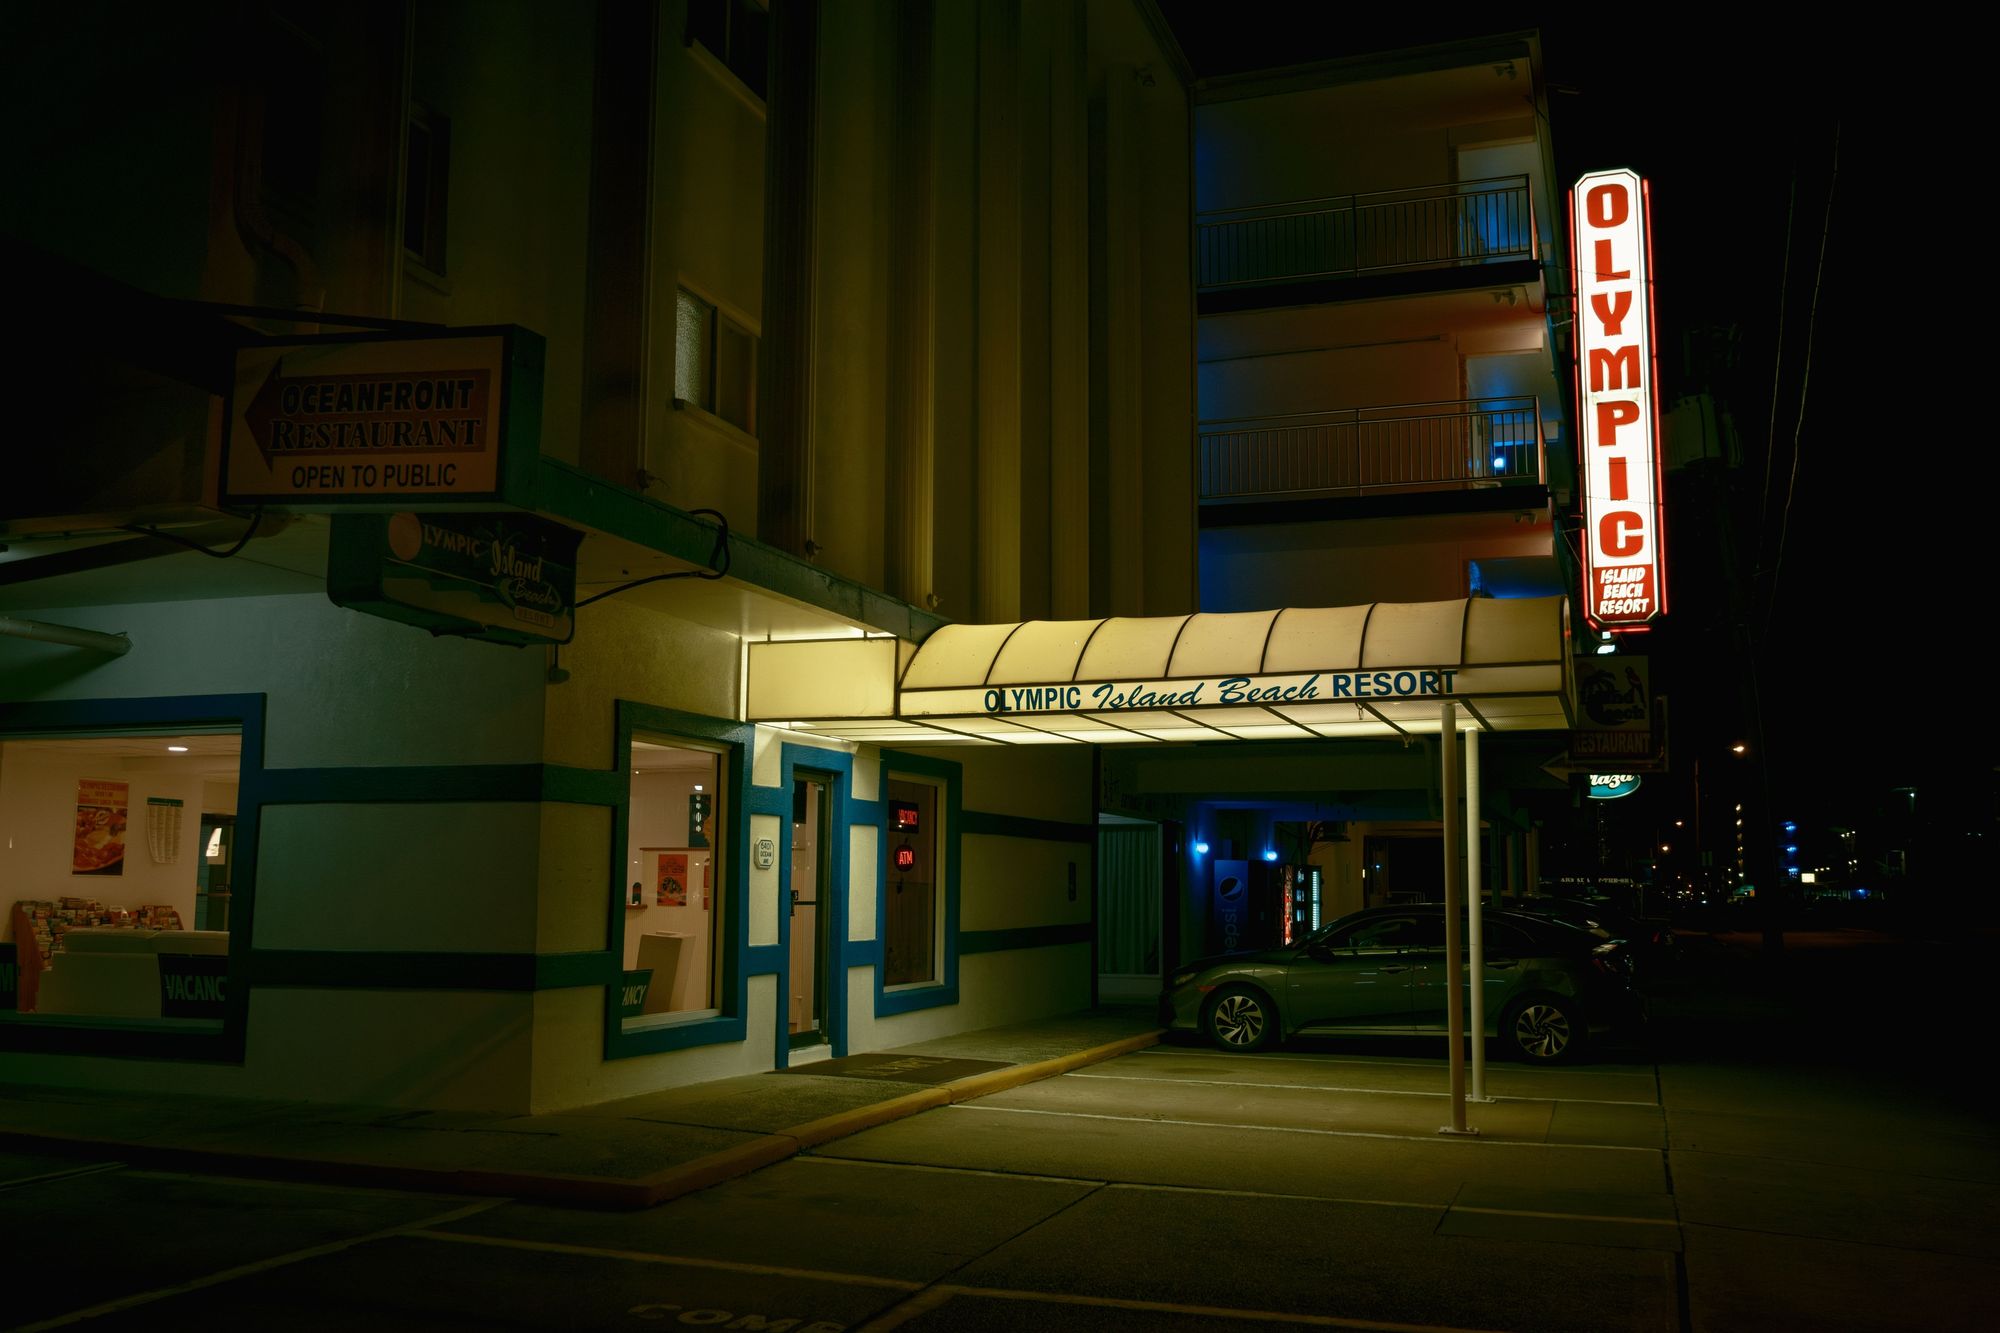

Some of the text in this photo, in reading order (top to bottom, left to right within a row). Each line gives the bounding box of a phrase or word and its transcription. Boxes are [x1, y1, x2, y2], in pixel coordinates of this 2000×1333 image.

[1587, 183, 1645, 558] OLYMPIC
[280, 379, 475, 416] OCEANFRONT
[270, 417, 482, 453] RESTAURANT
[292, 463, 456, 489] OPEN TO PUBLIC
[1600, 567, 1646, 584] ISLAND
[1603, 582, 1644, 599] BEACH
[1599, 598, 1650, 615] RESORT
[984, 670, 1459, 713] OLYMPIC Island Beach RESORT
[1574, 732, 1651, 753] RESTAURANT
[1589, 774, 1635, 789] laza
[899, 850, 913, 865] ATM
[163, 974, 228, 1003] VACANC
